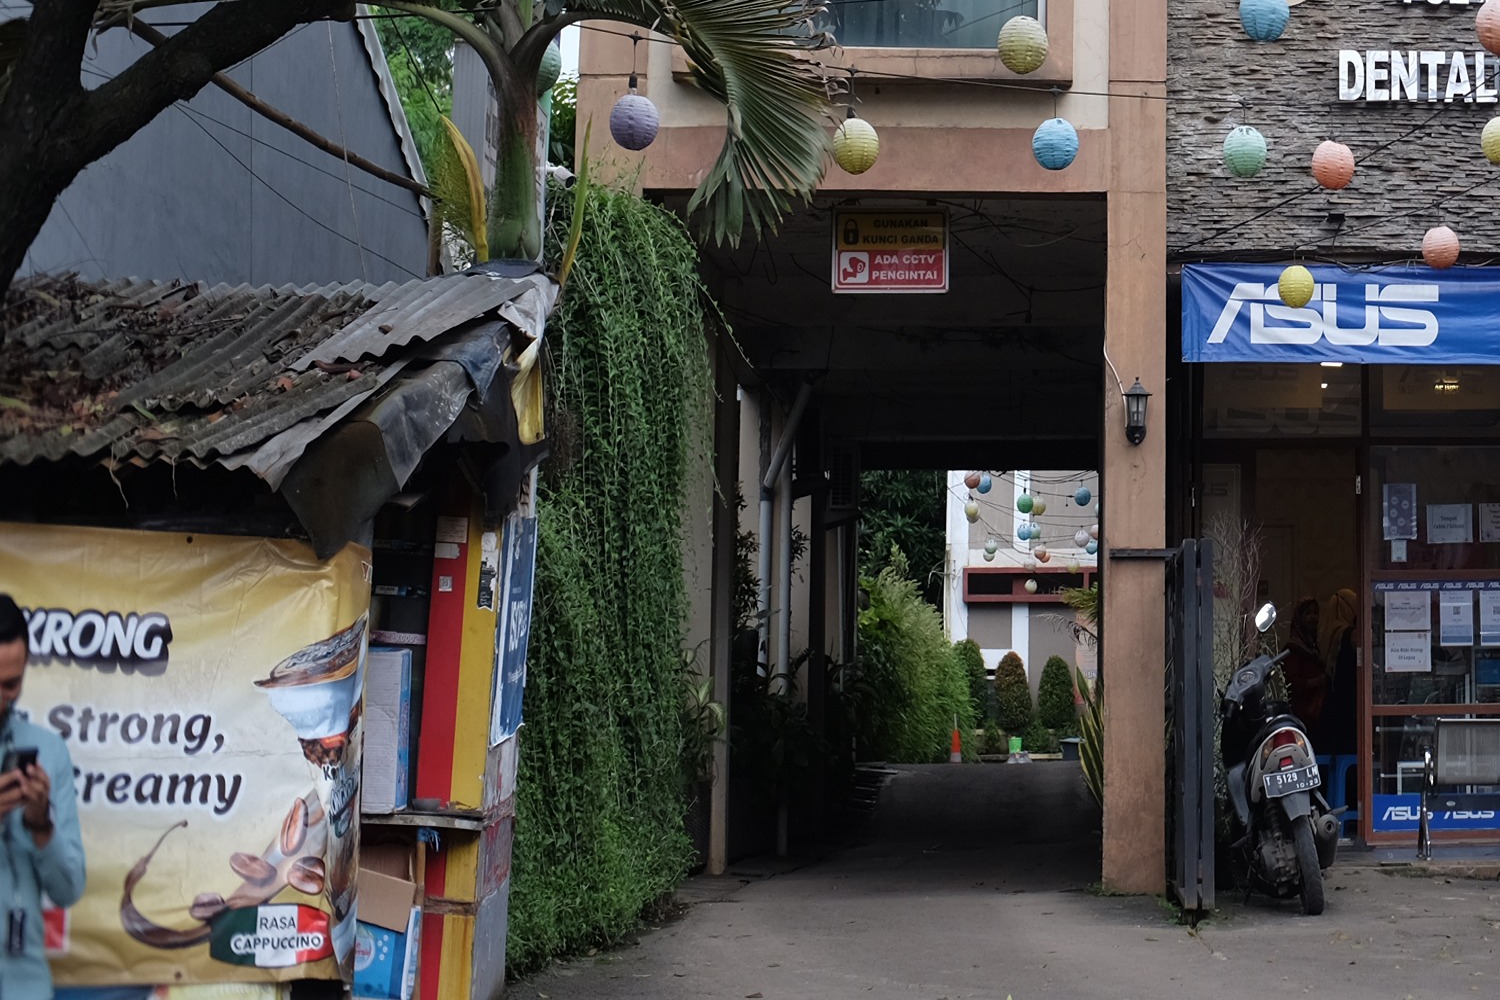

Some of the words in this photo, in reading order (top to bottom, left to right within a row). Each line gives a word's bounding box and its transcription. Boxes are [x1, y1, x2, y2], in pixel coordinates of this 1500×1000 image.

[1338, 50, 1499, 104] DENTAL
[873, 219, 928, 228] GUNAKAN
[862, 235, 897, 244] KUNCI
[901, 235, 939, 244] GANDA
[874, 255, 899, 264] ADA
[902, 255, 936, 264] CCTV
[872, 270, 938, 280] PENGINTAI
[1207, 282, 1439, 346] ASUS
[1276, 772, 1298, 785] 5129
[259, 916, 296, 931] RASA
[233, 934, 322, 950] CAPPUCCINO
